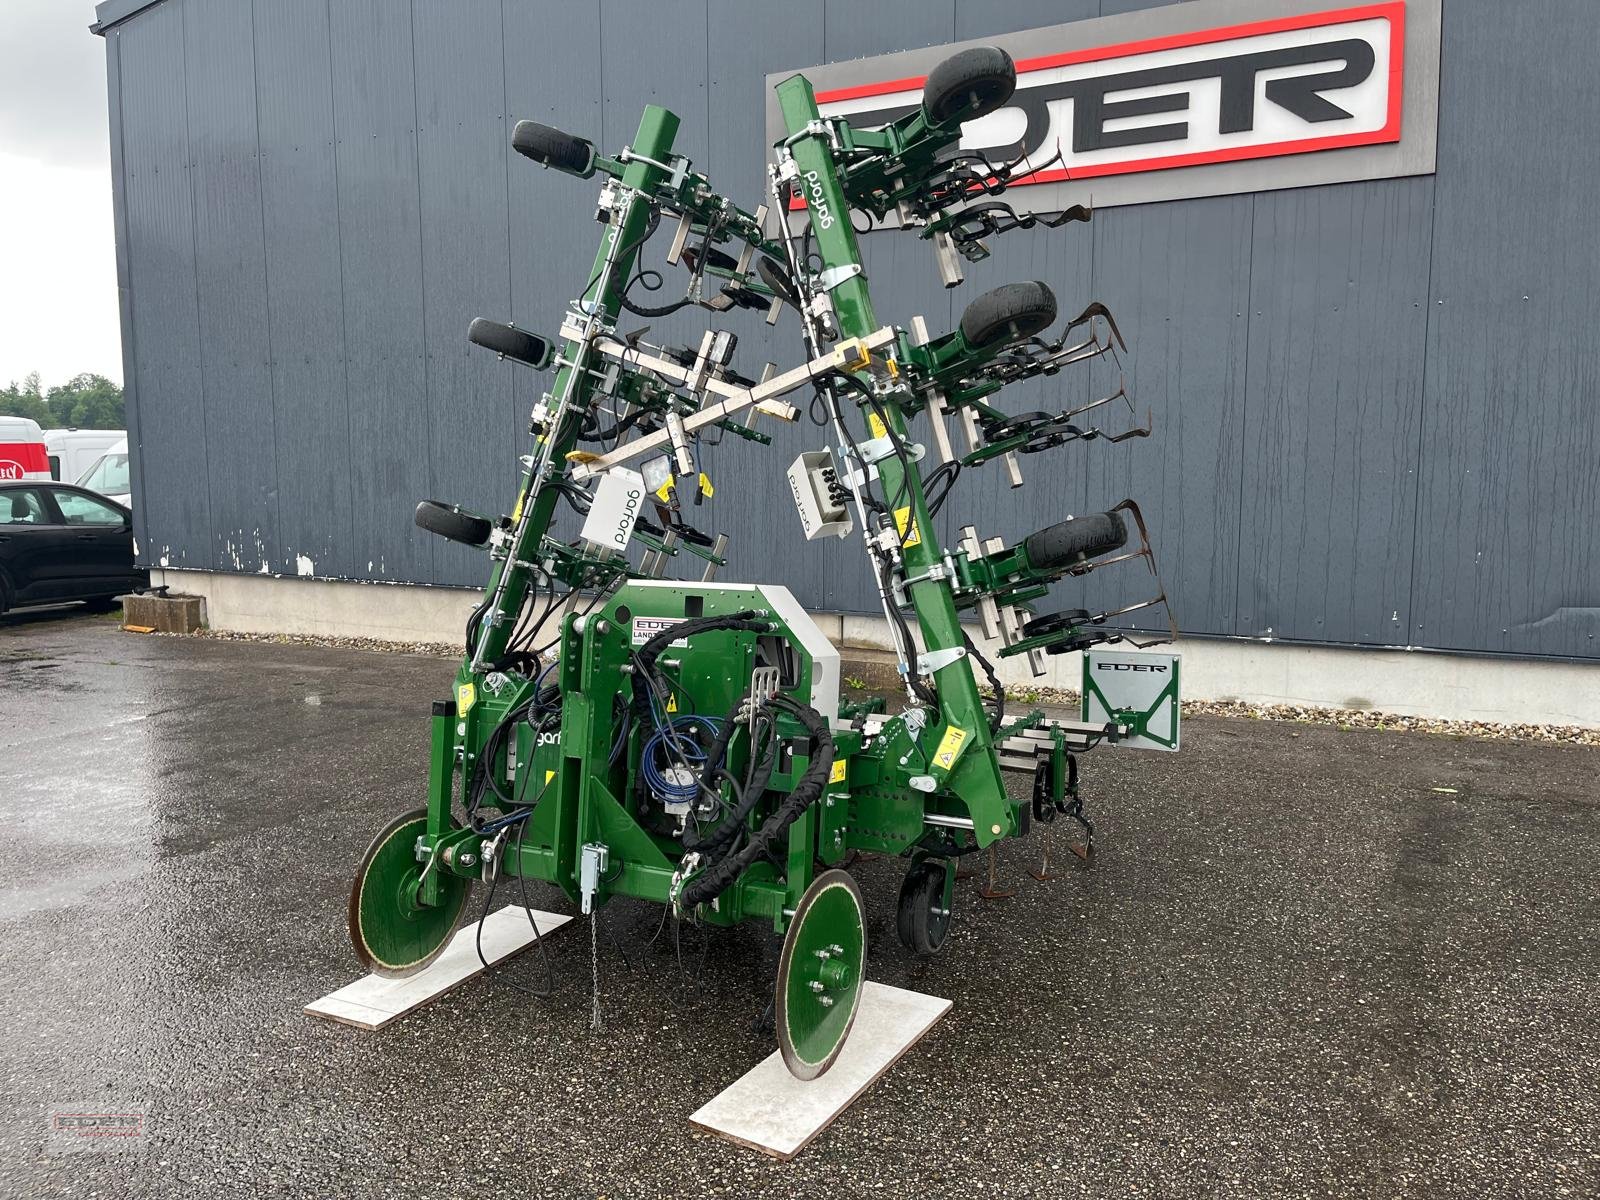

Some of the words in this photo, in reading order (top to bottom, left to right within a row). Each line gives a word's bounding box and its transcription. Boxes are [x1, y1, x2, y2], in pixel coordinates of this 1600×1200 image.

[832, 38, 1375, 168] DER
[803, 170, 835, 230] garford
[0, 464, 17, 479] ELY
[614, 489, 640, 545] garford
[789, 474, 811, 532] garford
[636, 620, 675, 629] EDE
[1096, 662, 1168, 673] EDER
[537, 731, 562, 747] garf
